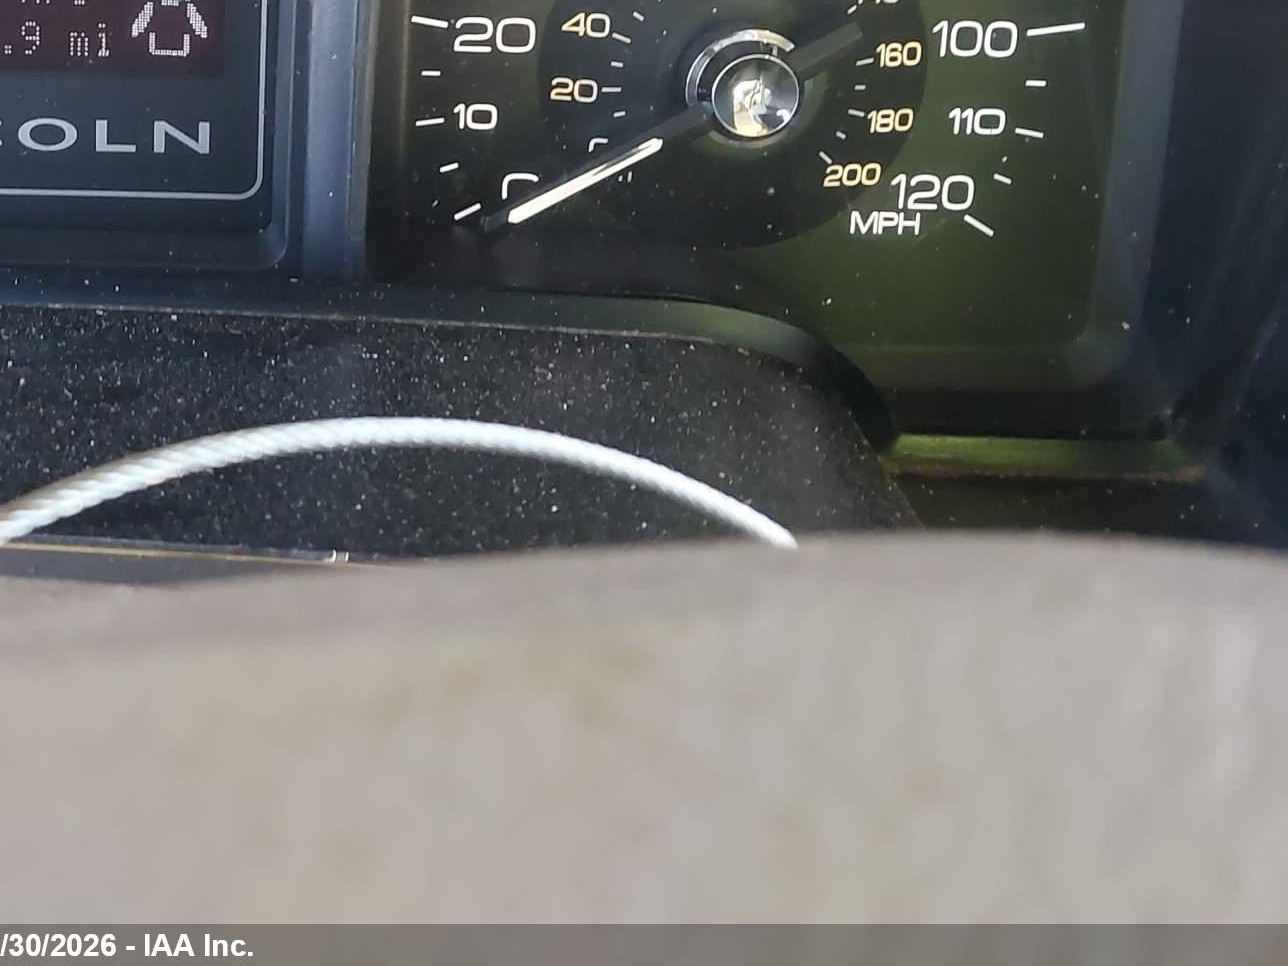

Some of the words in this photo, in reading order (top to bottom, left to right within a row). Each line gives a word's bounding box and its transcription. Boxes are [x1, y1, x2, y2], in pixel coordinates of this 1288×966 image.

[453, 16, 536, 53] 20
[561, 12, 611, 38] 40
[932, 20, 1018, 58] 100
[70, 23, 110, 57] mi
[876, 41, 922, 68] 160
[550, 77, 598, 103] 20
[453, 103, 498, 130] 10
[867, 108, 914, 134] 180
[948, 107, 1006, 135] 110
[823, 158, 882, 187] 200
[889, 173, 975, 212] 120
[849, 208, 922, 236] MPH
